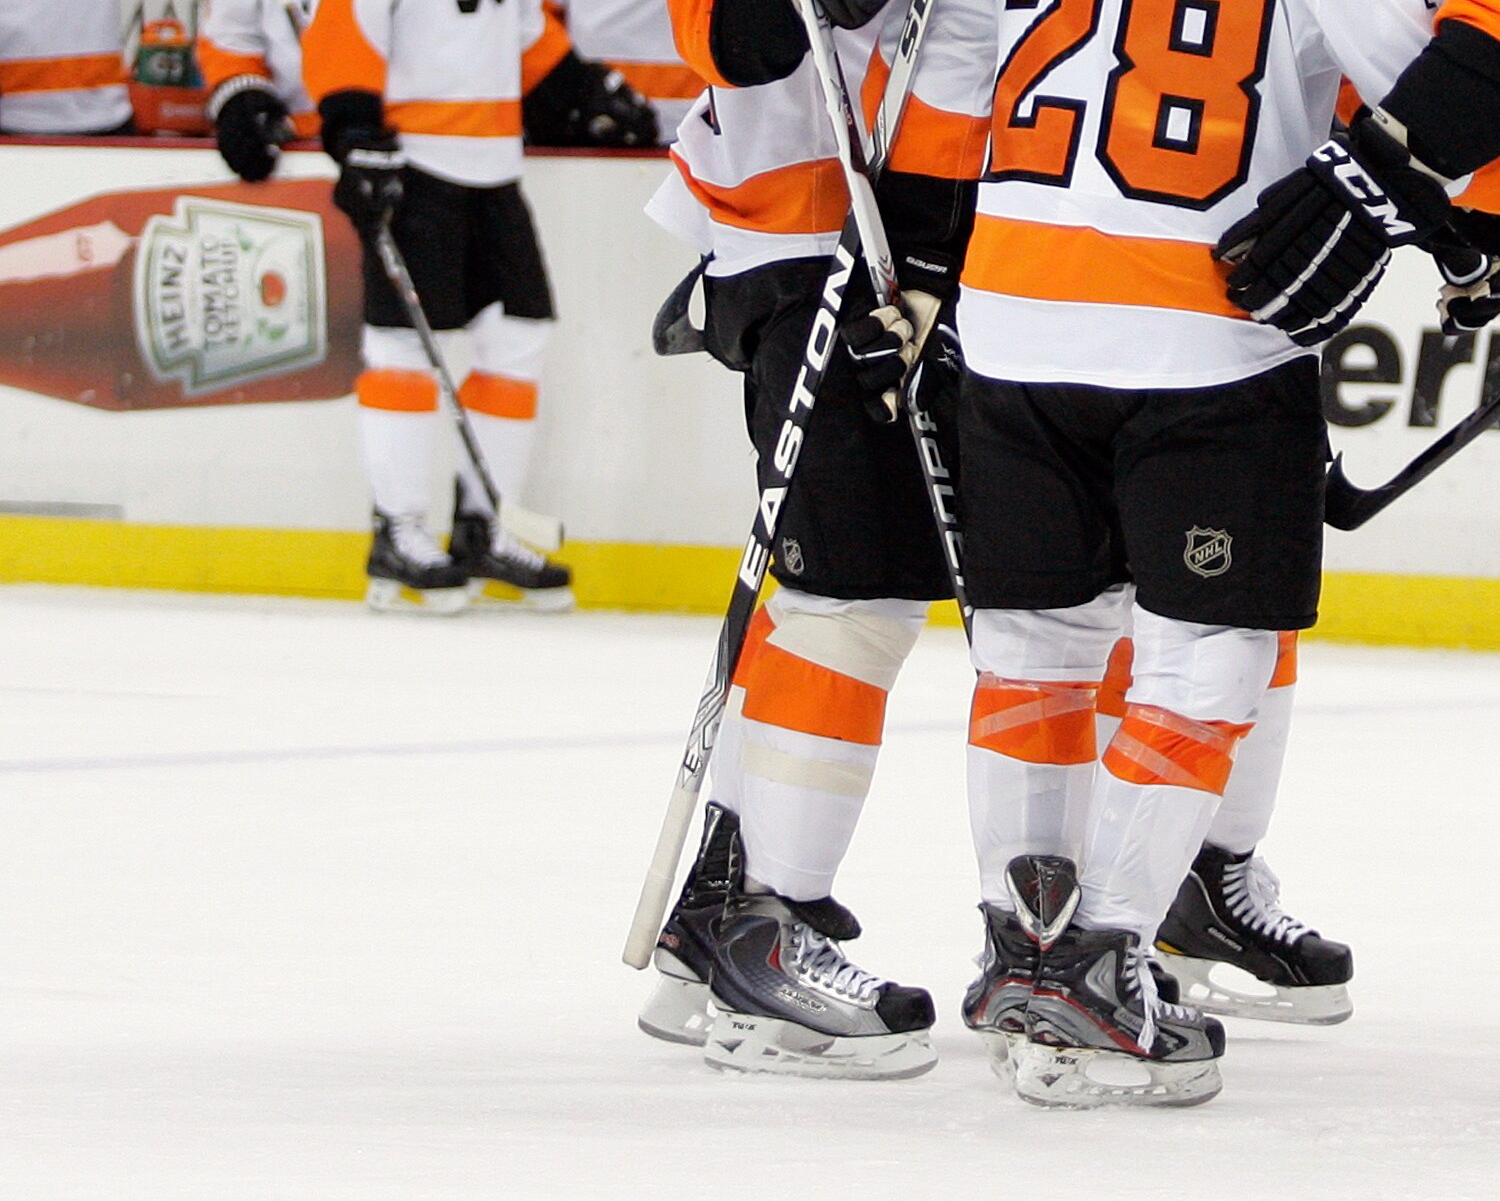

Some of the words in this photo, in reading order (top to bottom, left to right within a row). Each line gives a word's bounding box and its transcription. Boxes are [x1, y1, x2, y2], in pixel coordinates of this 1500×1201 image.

[1313, 140, 1416, 236] CCM
[161, 244, 193, 350] HEINZ
[738, 244, 855, 592] EASTON
[1194, 541, 1223, 564] NHL
